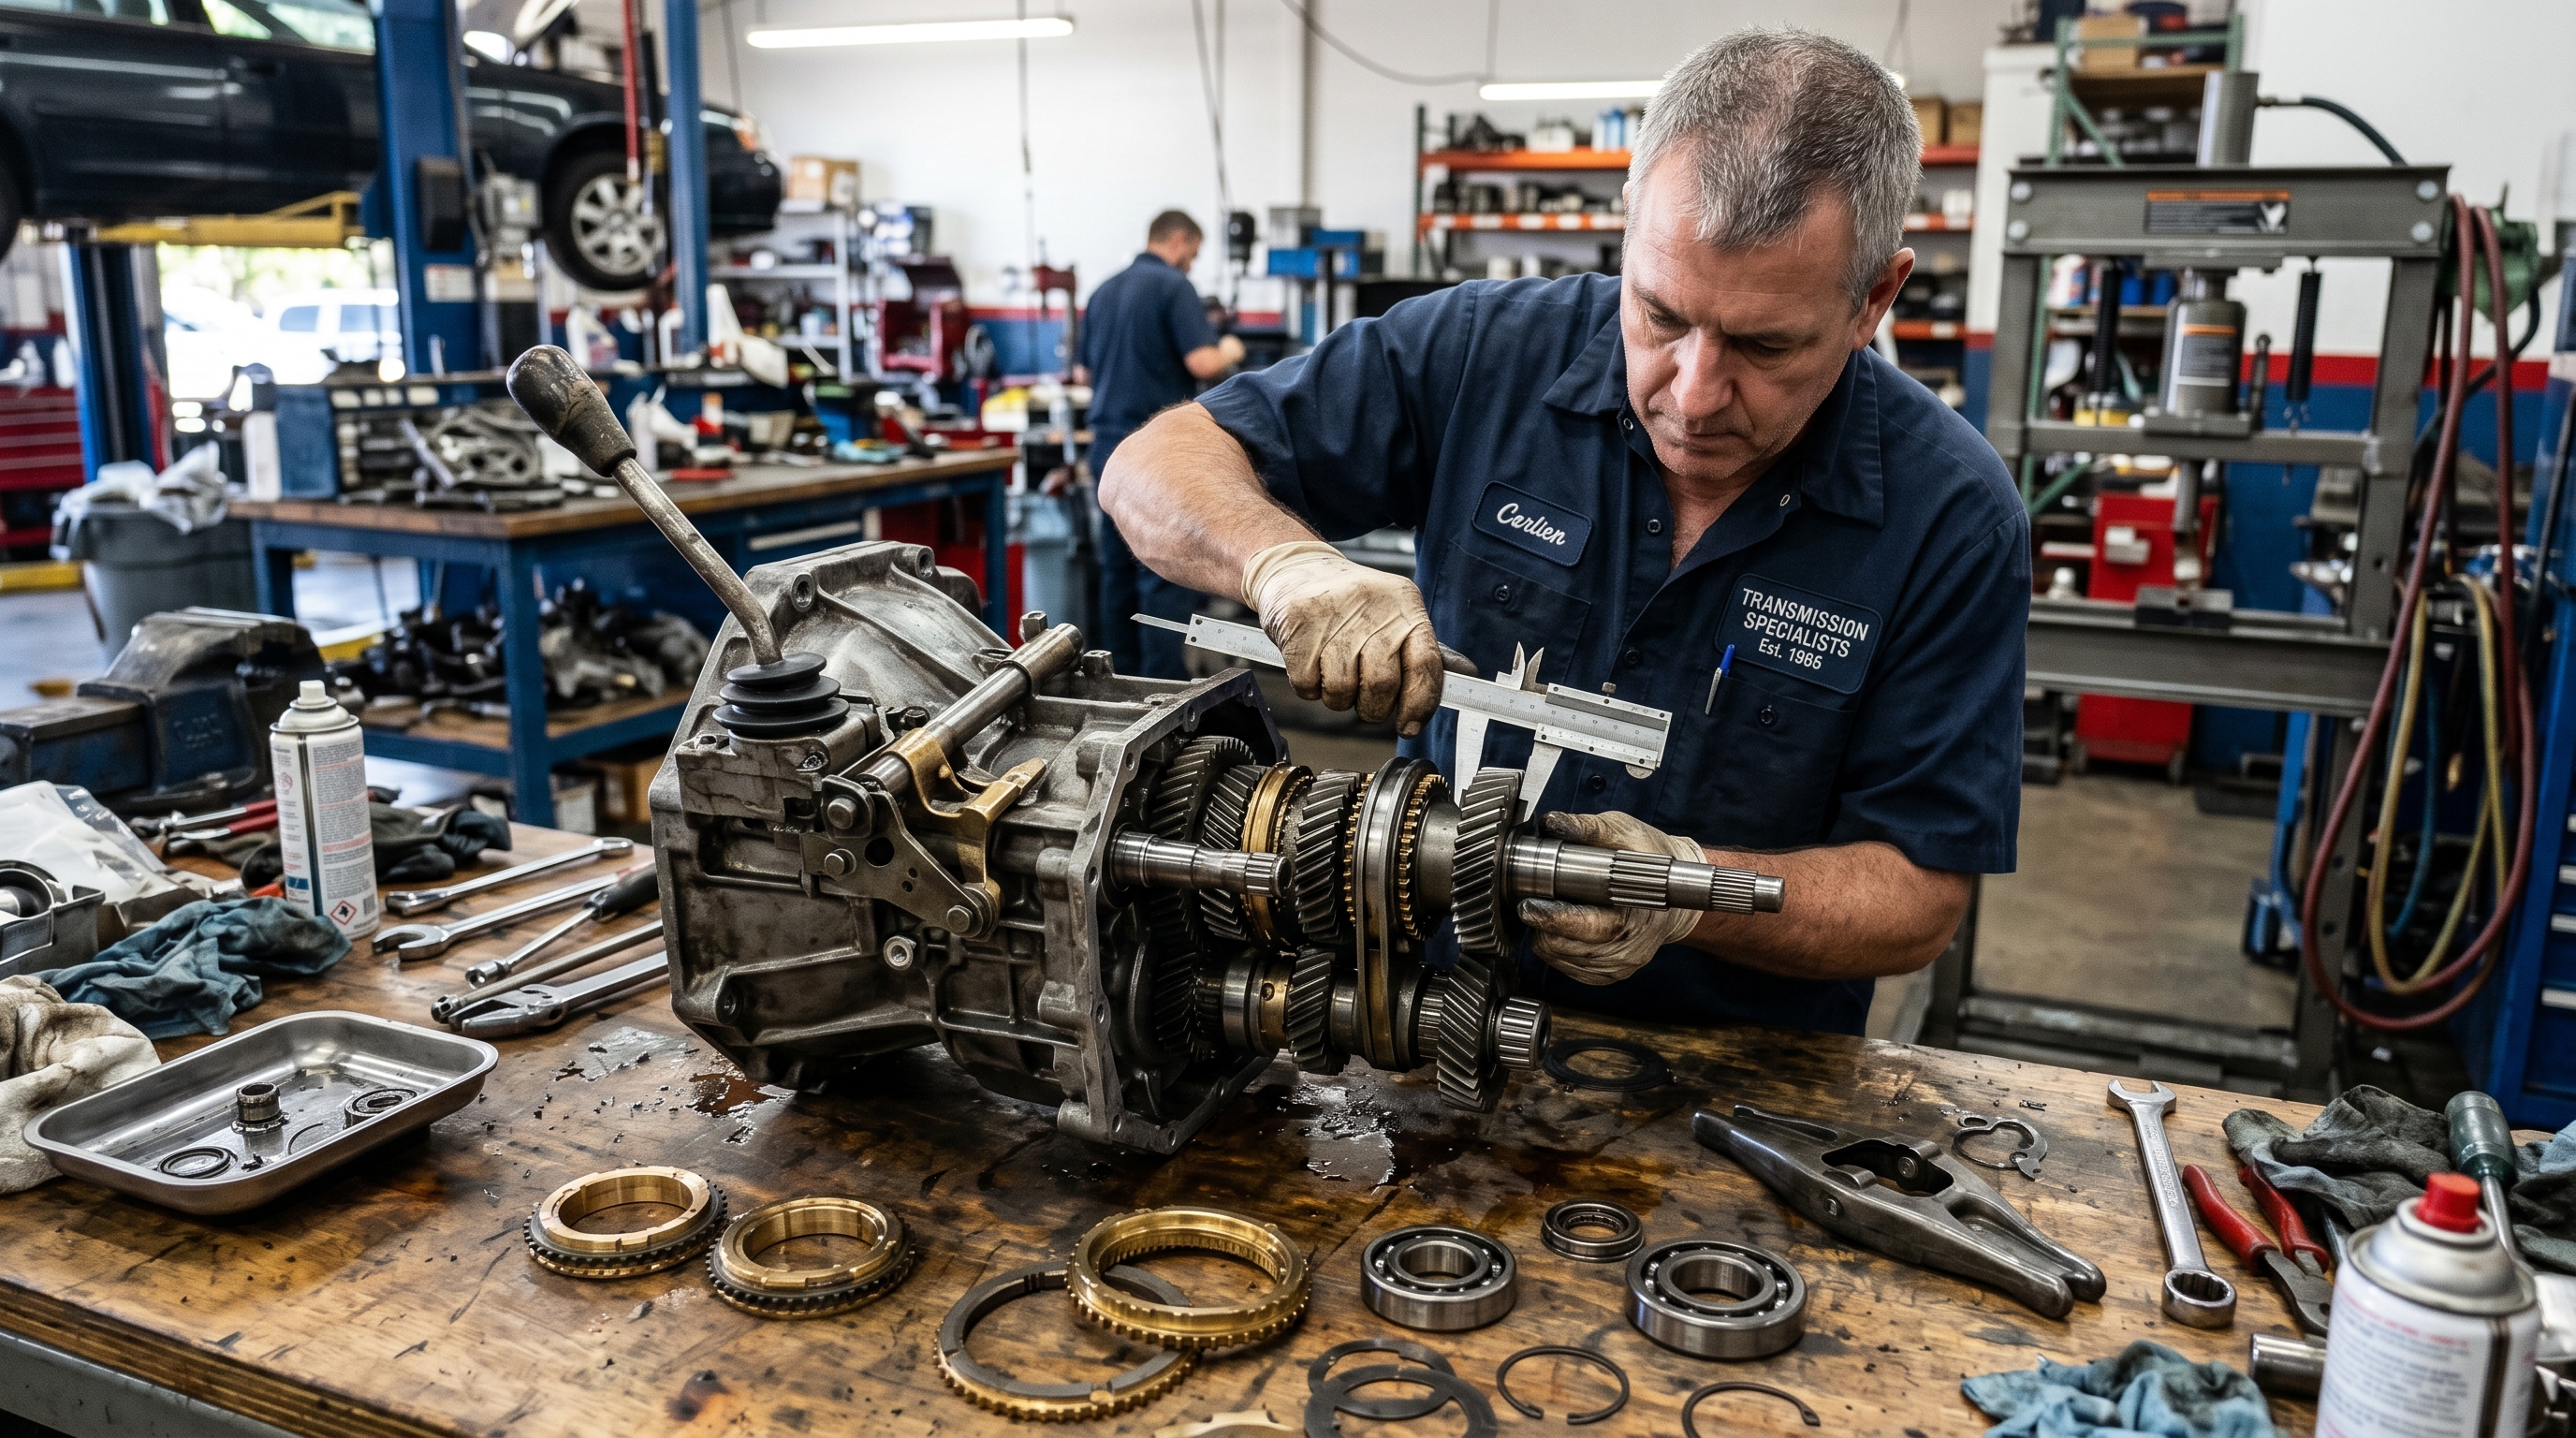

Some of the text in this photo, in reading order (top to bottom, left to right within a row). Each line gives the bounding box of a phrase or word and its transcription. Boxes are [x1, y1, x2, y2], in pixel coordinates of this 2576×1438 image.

[1742, 587, 1869, 641] TRANSMISSION
[1743, 611, 1851, 658] SPECIALISTS
[1758, 638, 1782, 659] Est.
